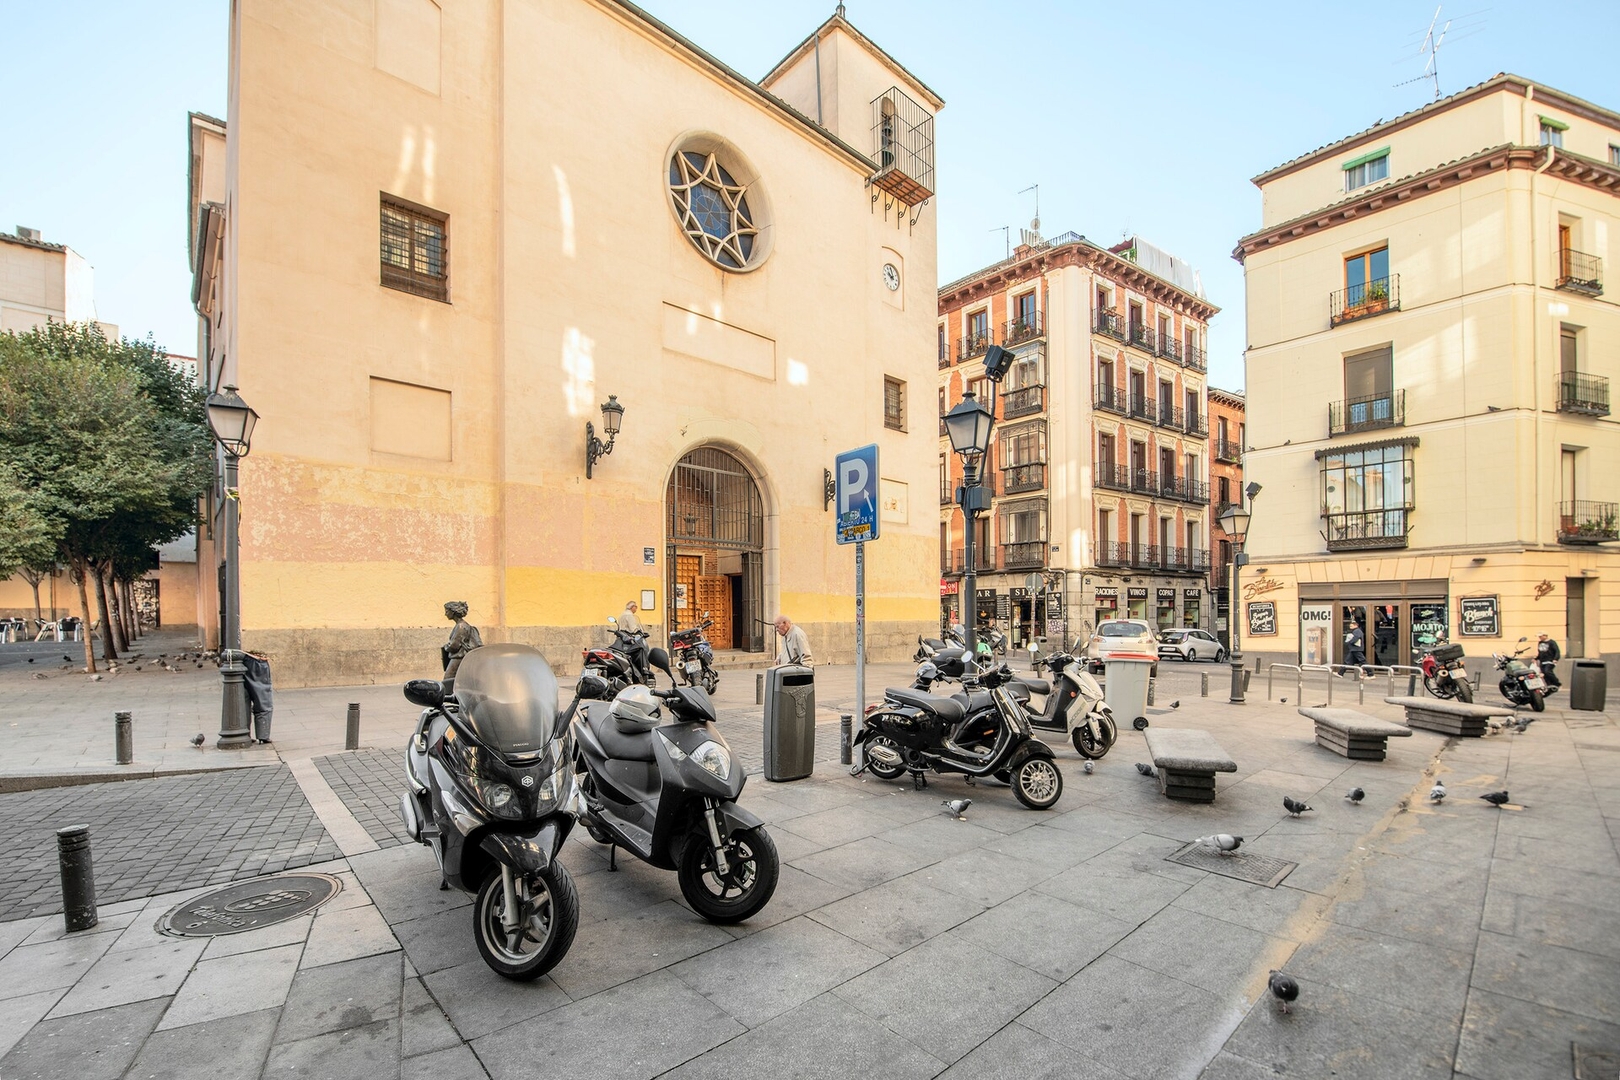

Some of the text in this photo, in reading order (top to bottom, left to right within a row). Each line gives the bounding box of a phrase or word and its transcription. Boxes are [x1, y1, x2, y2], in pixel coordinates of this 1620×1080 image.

[840, 458, 868, 514] P
[861, 516, 868, 525] 24
[976, 590, 991, 598] AR
[1095, 587, 1119, 596] RACIONES
[1129, 588, 1146, 596] VINOS
[1303, 611, 1331, 621] OMG!
[1413, 624, 1445, 632] MOJITO
